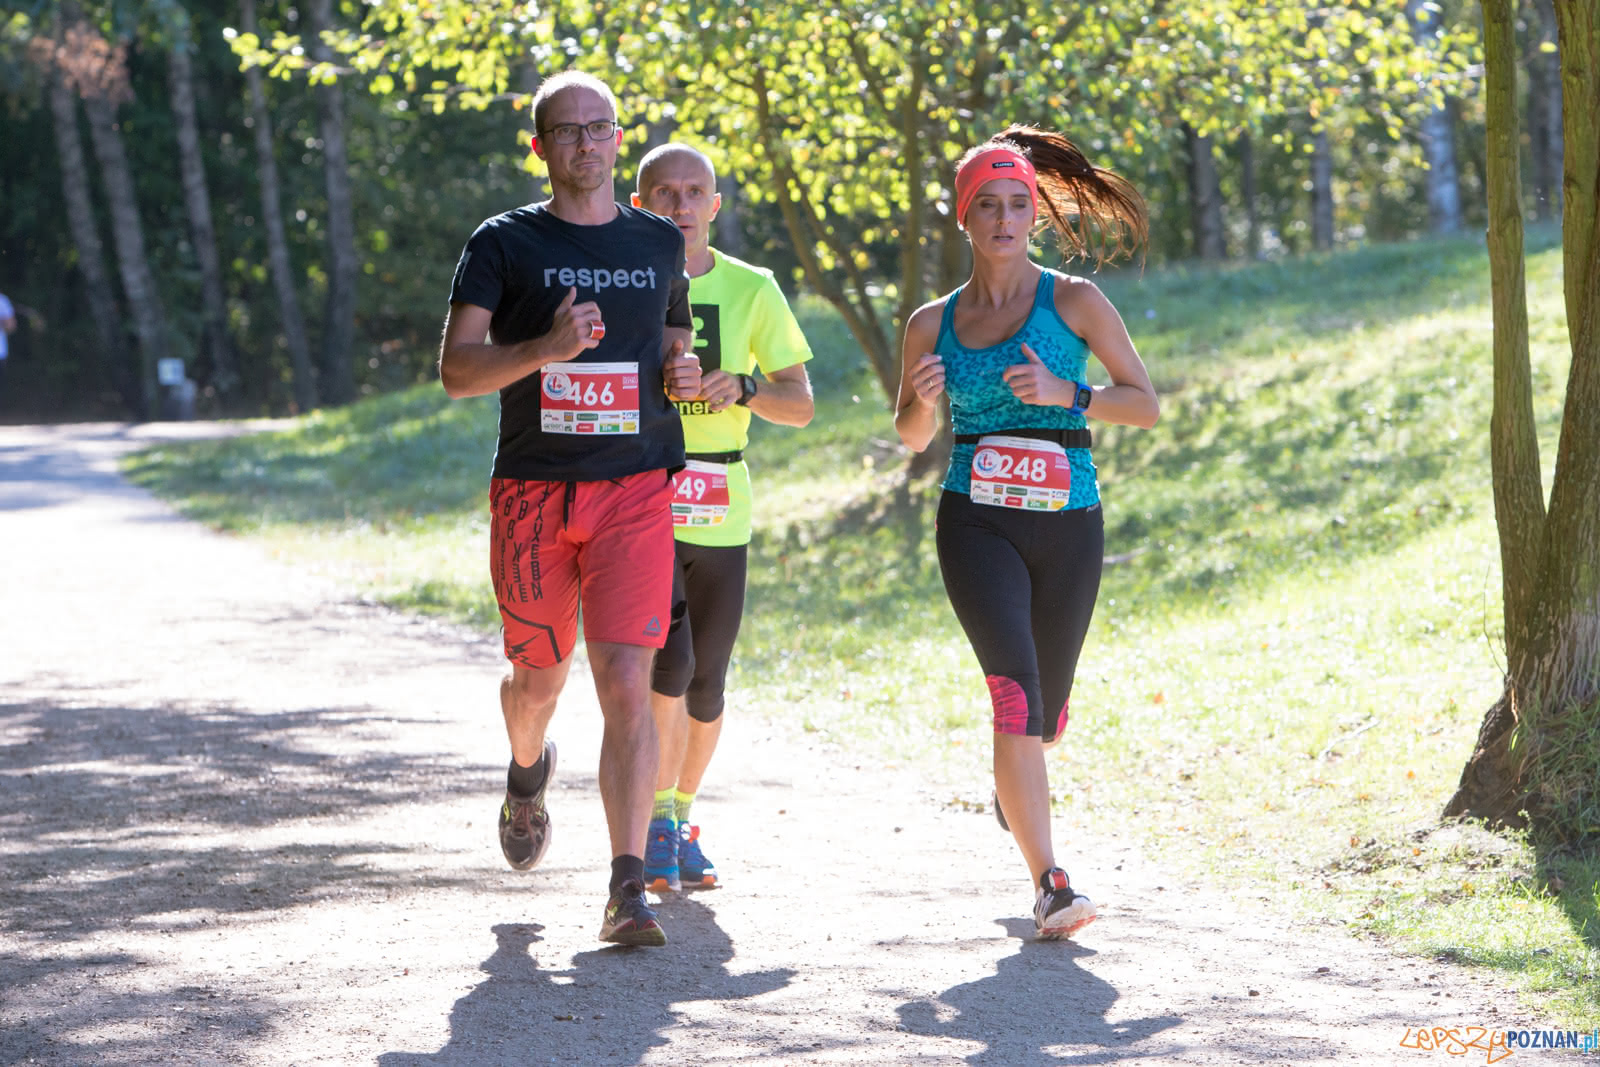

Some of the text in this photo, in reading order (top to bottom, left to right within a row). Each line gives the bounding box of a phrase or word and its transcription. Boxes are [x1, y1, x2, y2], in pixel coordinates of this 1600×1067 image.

[543, 266, 657, 293] respect
[566, 381, 615, 406] 466
[996, 454, 1047, 482] 248
